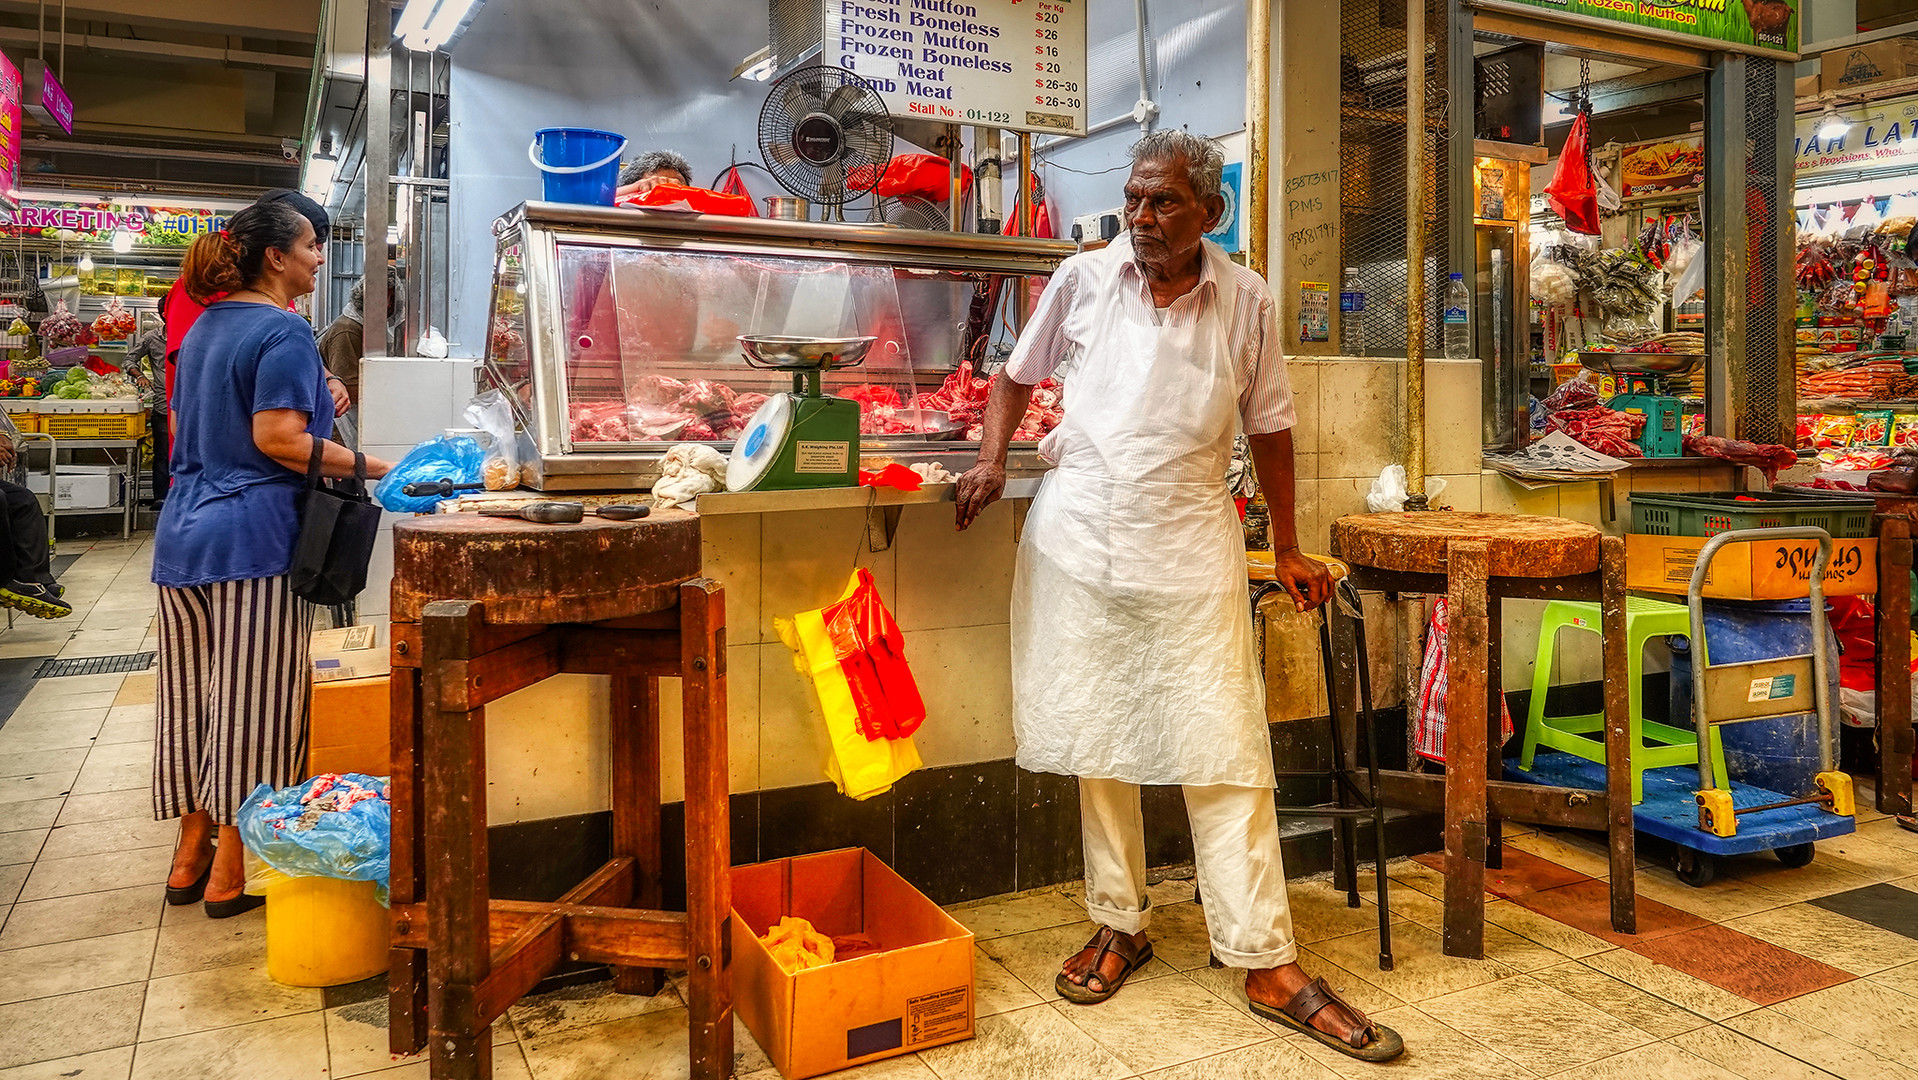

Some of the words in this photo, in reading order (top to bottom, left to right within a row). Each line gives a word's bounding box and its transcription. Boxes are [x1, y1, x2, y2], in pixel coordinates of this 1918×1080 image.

[910, 0, 976, 17] Mutton
[1039, 2, 1051, 10] Per
[1054, 4, 1064, 13] Kg
[1640, 3, 1696, 24] Mutton
[841, 0, 900, 23] Fresh
[909, 11, 1000, 38] Boneless
[841, 18, 914, 43] Frozen
[923, 31, 989, 53] Mutton
[841, 36, 914, 60] Frozen
[922, 48, 1012, 74] Boneless
[899, 61, 945, 82] Meat
[906, 81, 953, 100] Meat
[909, 102, 935, 115] Stall
[940, 105, 954, 117] No
[966, 109, 1010, 123] 01-122
[1285, 170, 1338, 194] 85873817
[163, 214, 232, 234] #01-16
[1776, 546, 1862, 578] Grnde
